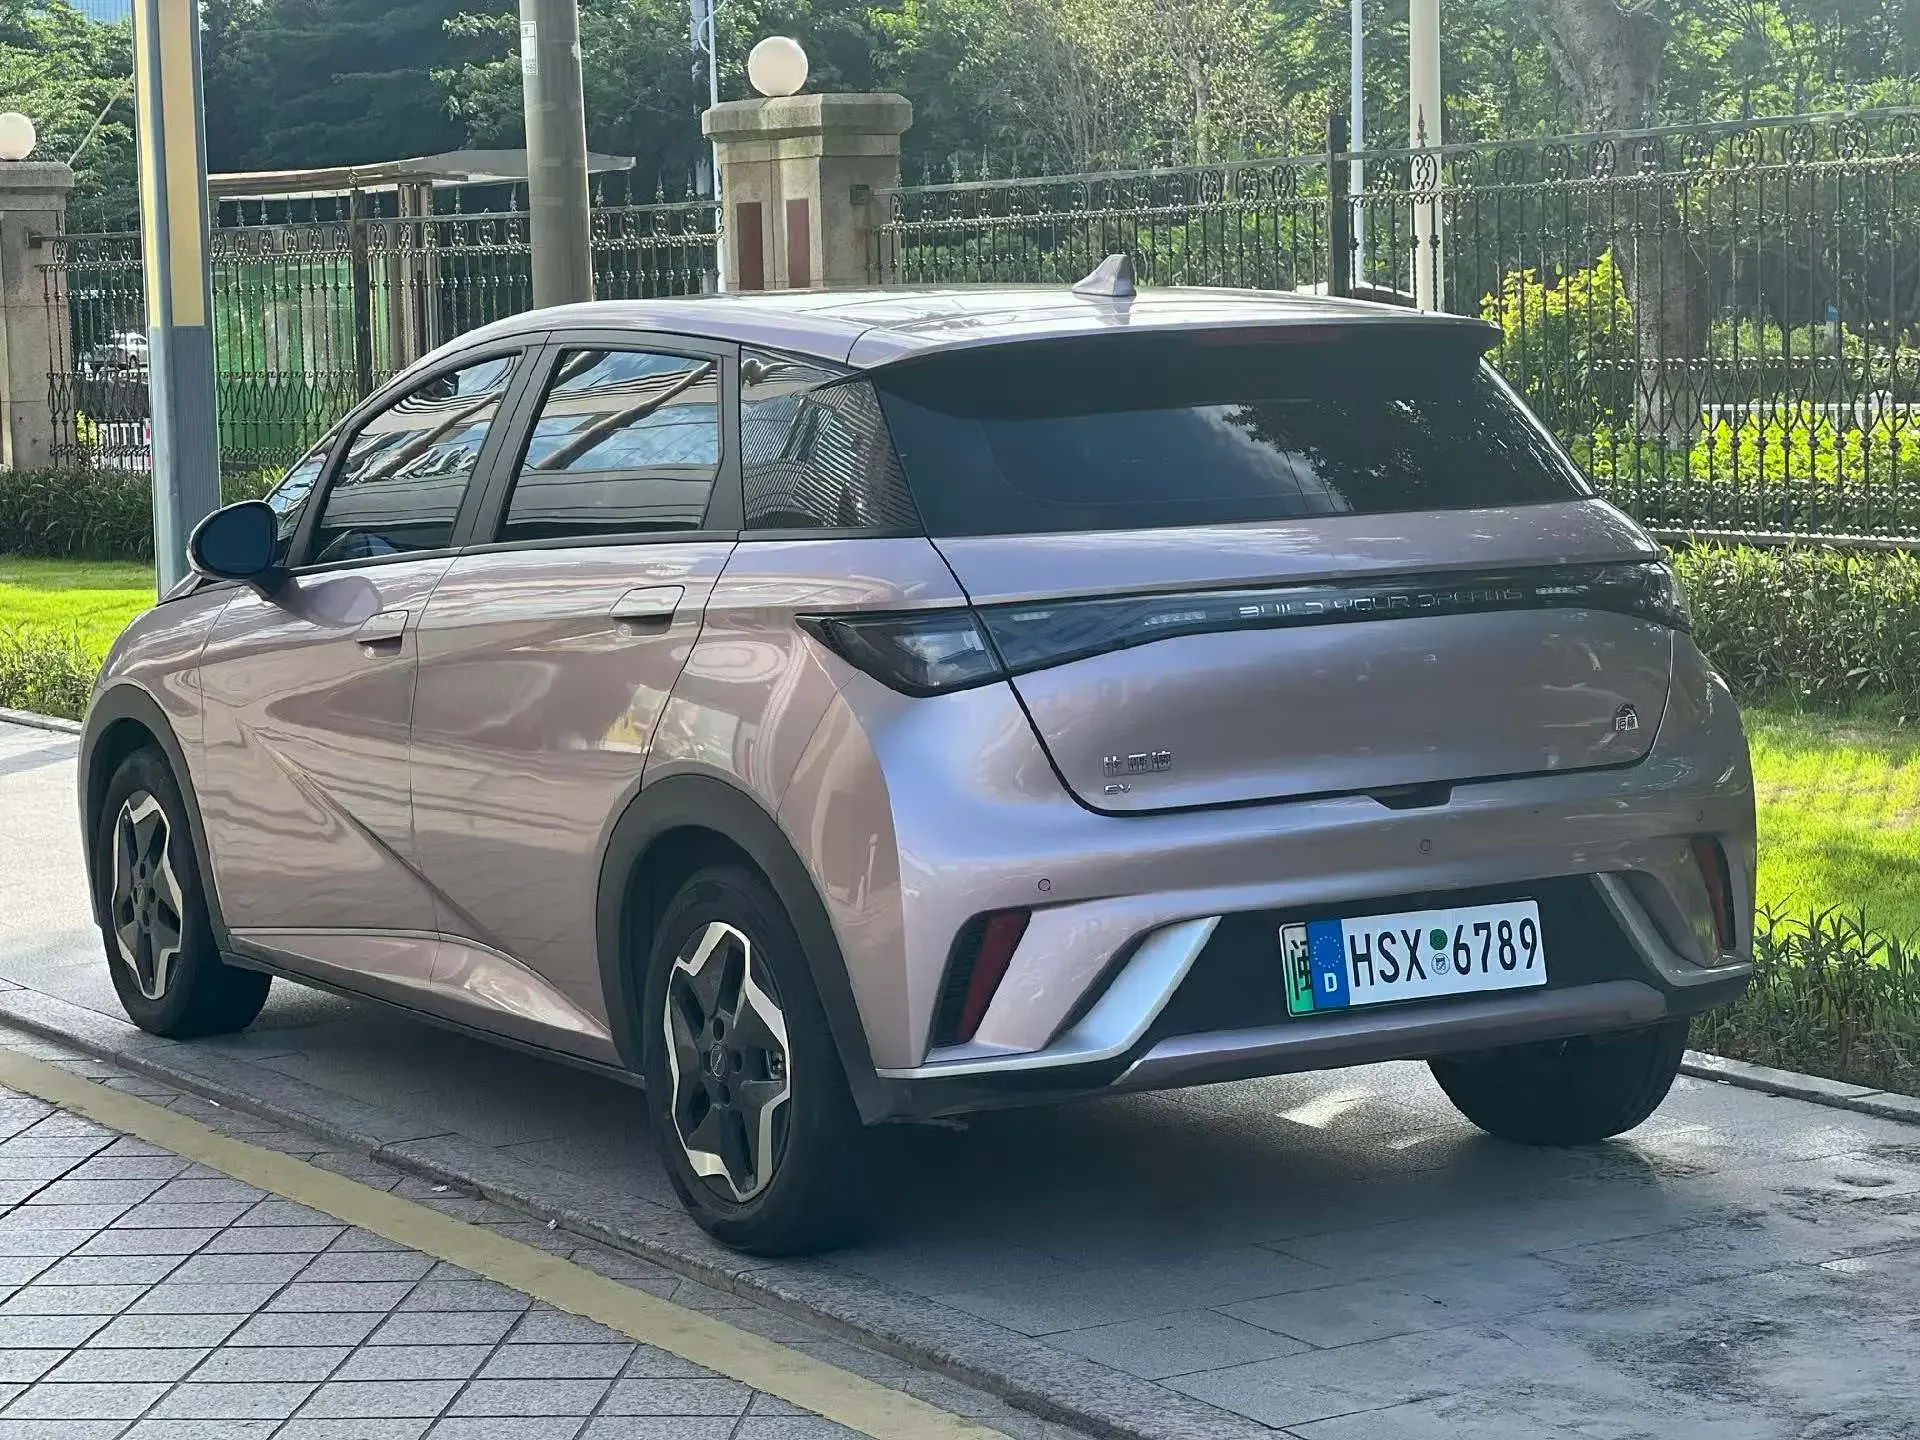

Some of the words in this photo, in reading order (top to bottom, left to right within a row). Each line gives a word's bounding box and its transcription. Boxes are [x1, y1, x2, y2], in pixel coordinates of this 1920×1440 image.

[1239, 602, 1324, 618] BUILD
[1334, 595, 1410, 613] YOUR
[1104, 784, 1132, 796] EV
[1350, 928, 1427, 988] HSX
[1452, 917, 1538, 976] 6789
[1323, 972, 1338, 993] D
